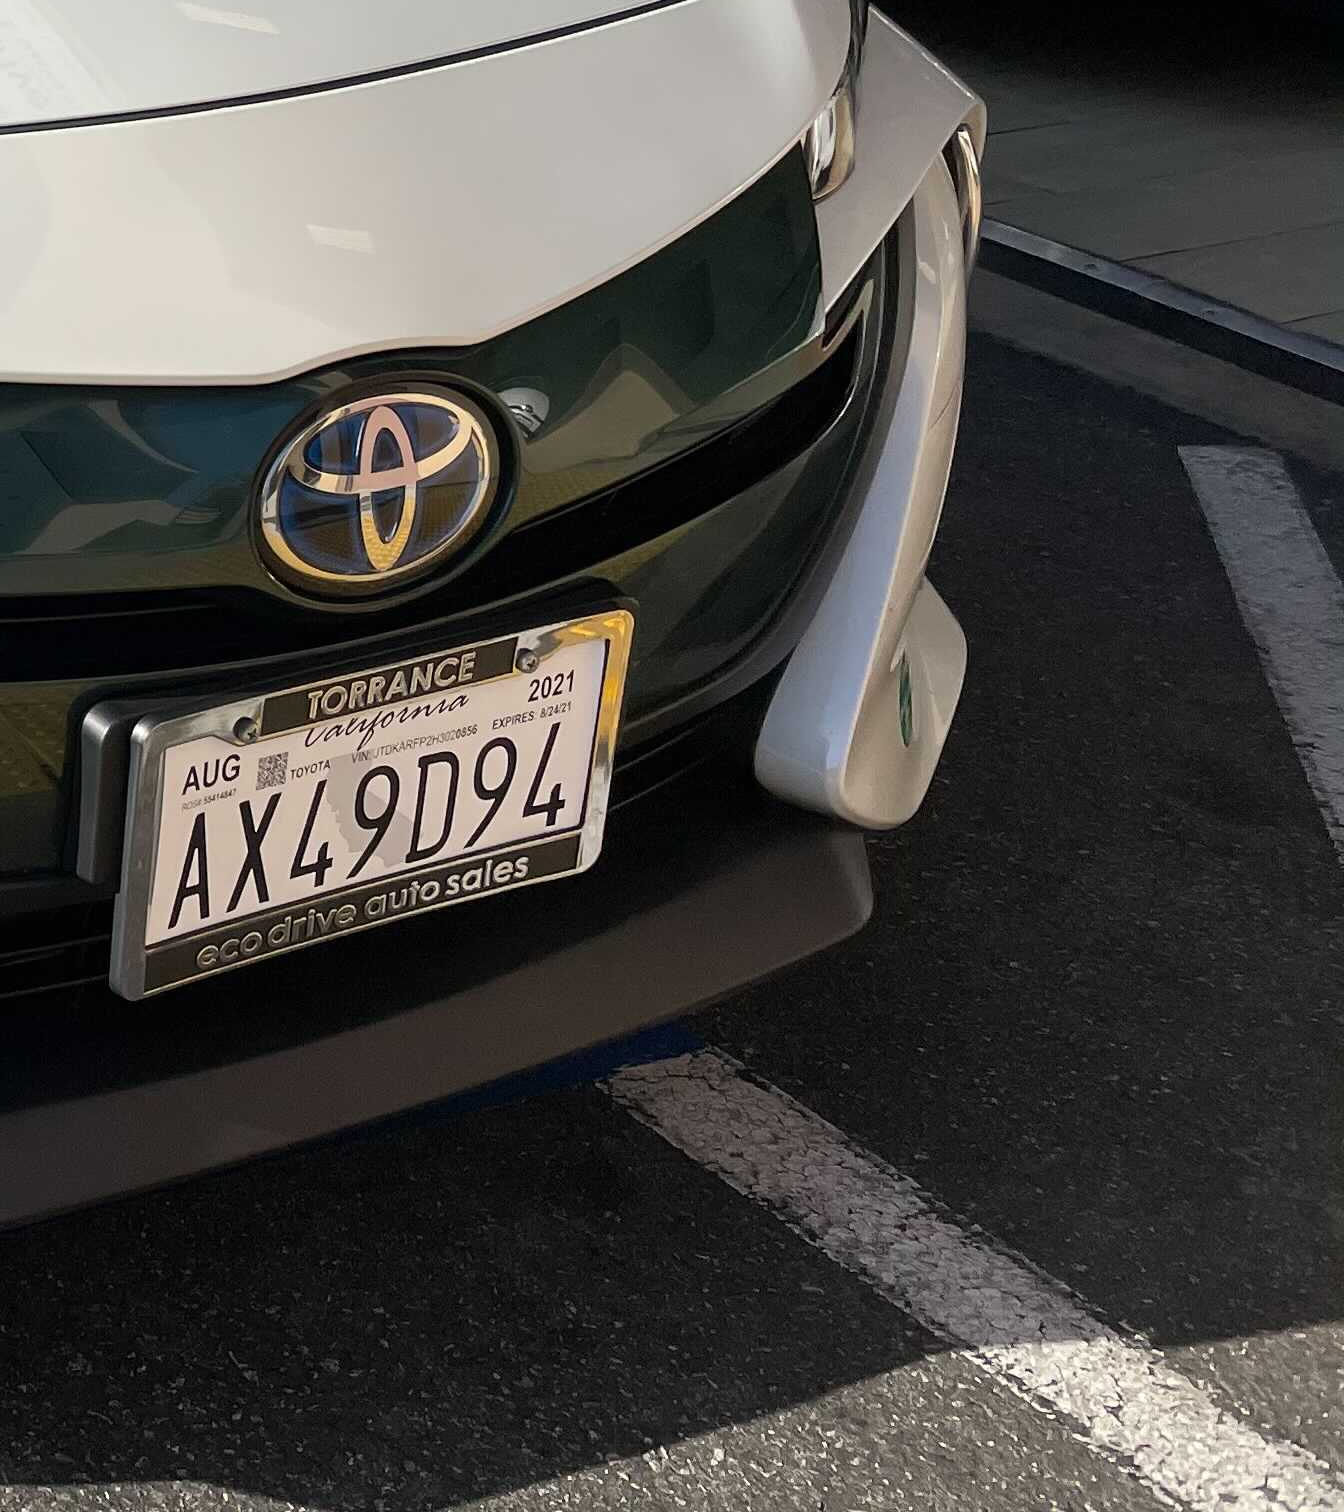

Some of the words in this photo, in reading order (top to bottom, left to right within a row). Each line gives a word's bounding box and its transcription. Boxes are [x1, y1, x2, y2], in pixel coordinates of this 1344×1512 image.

[307, 651, 477, 720] TORRANCE
[528, 669, 575, 703] 2021
[304, 694, 470, 751] California
[181, 753, 242, 796] AUG
[290, 759, 331, 781] TOYOTA
[169, 722, 567, 929] AX49D94
[196, 931, 263, 969] eco
[267, 903, 357, 948] drive
[364, 878, 442, 922] auto
[443, 854, 530, 898] sales
